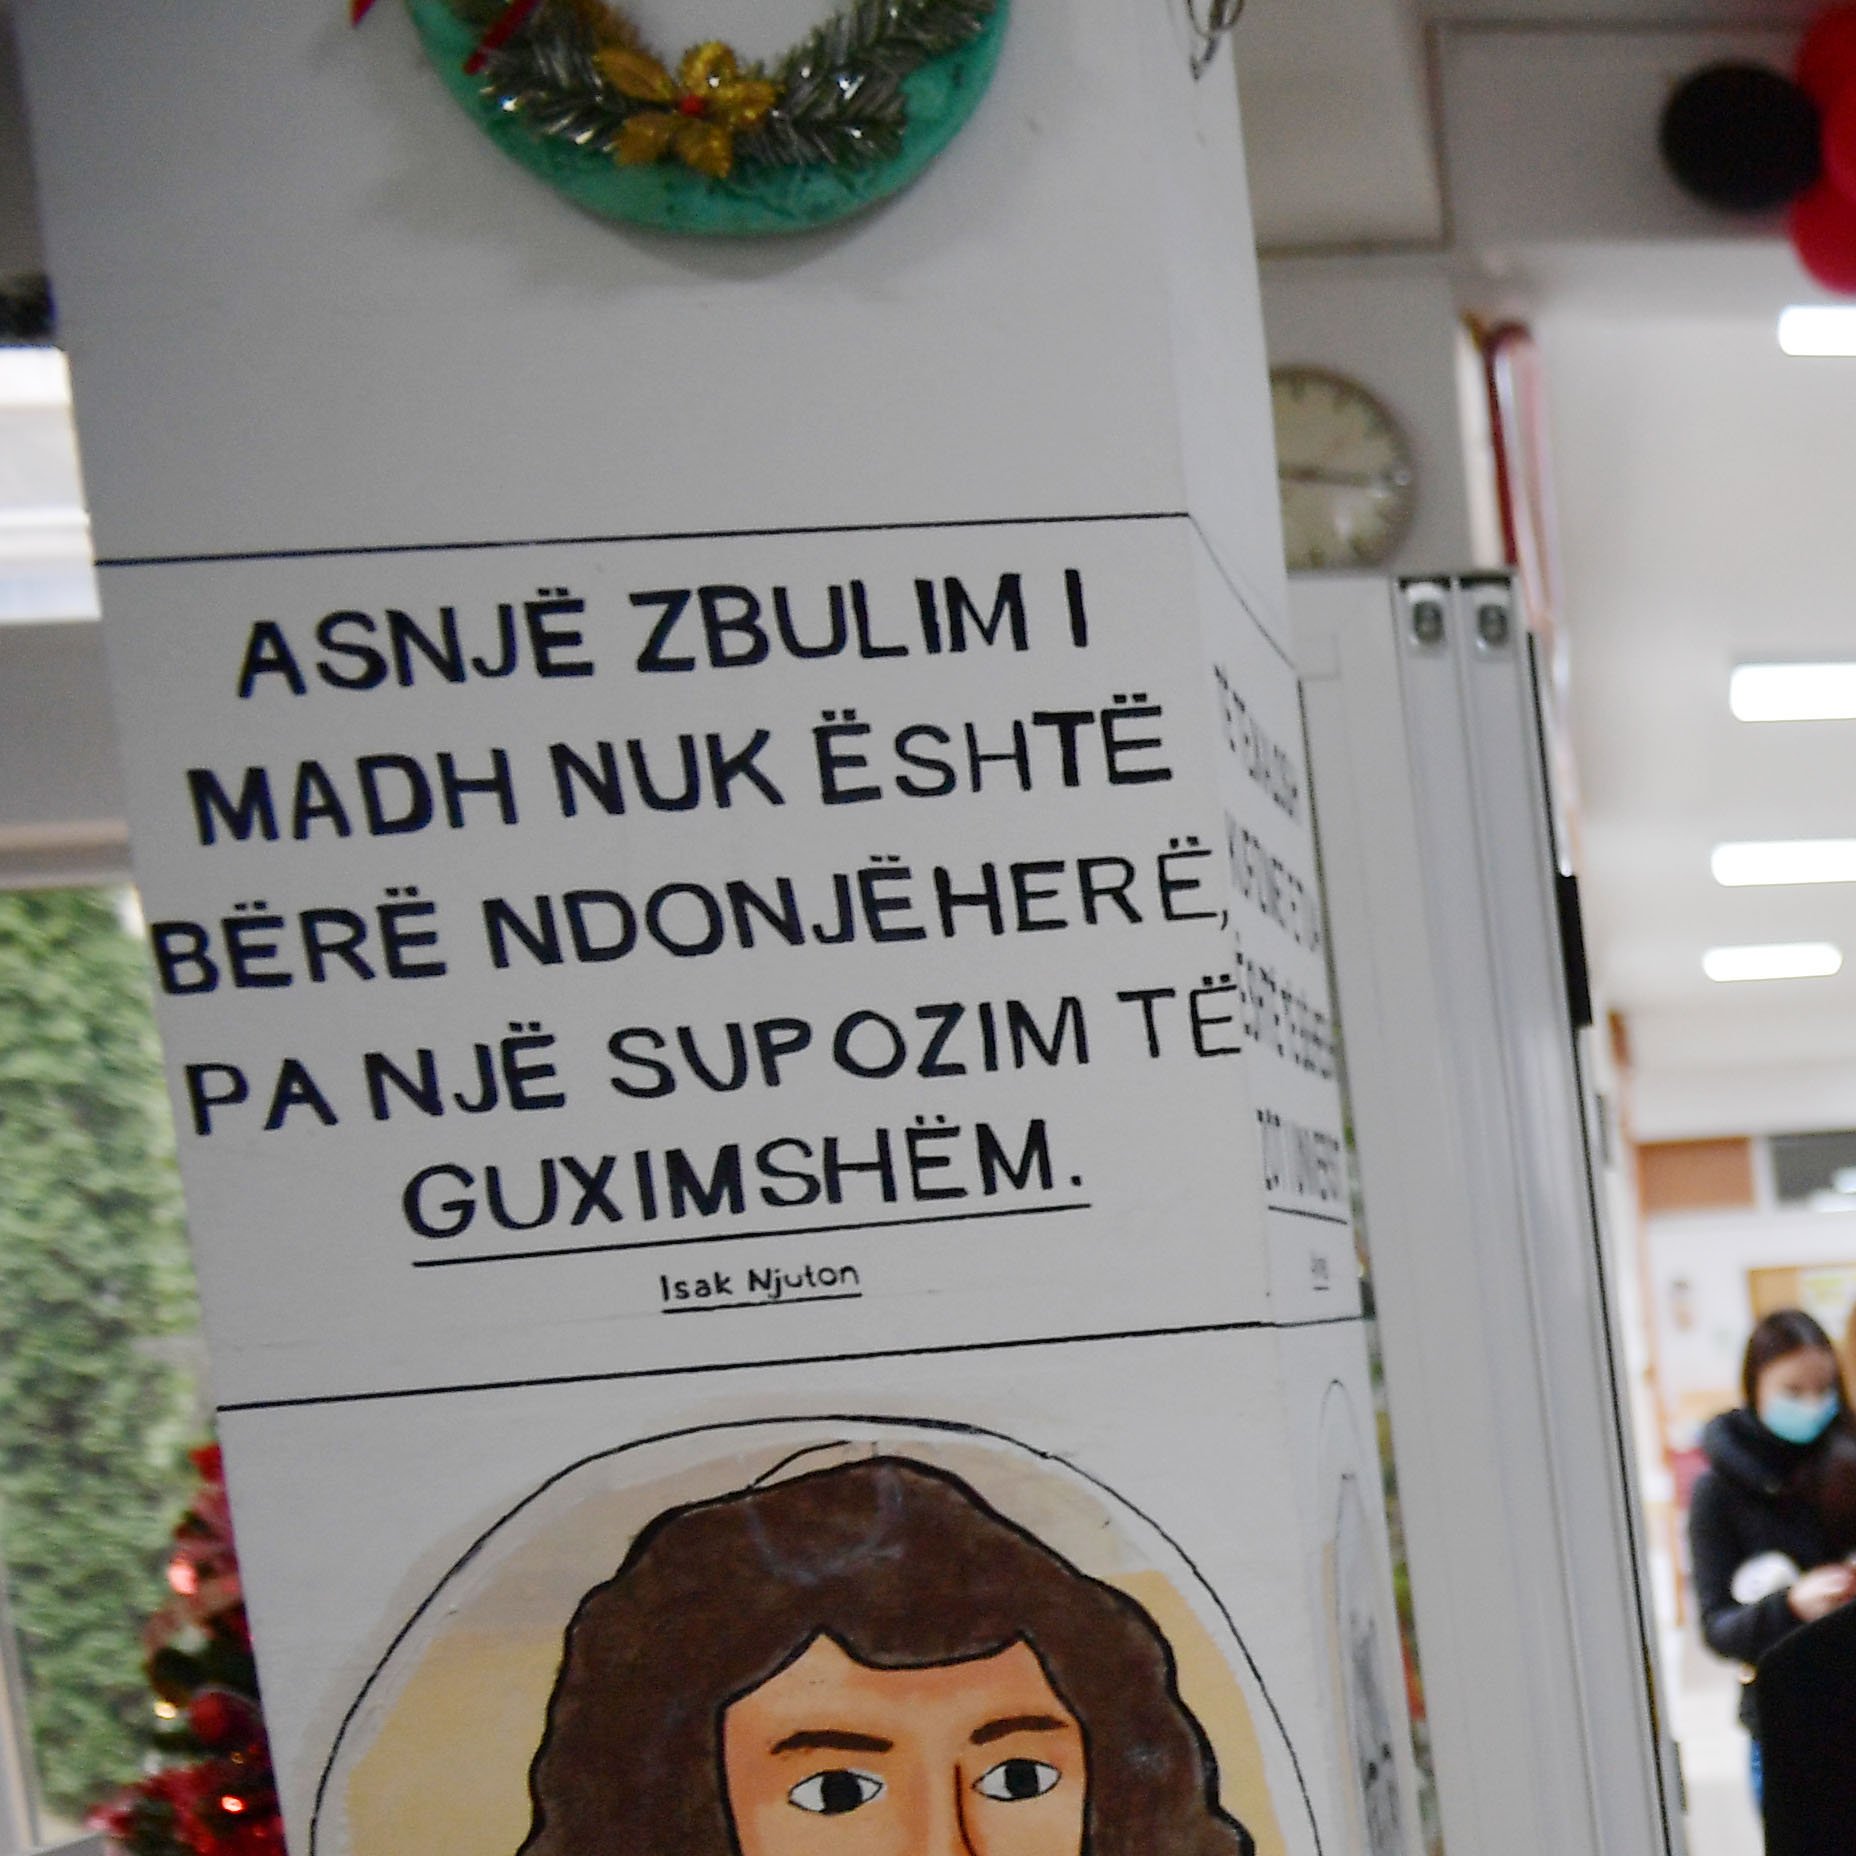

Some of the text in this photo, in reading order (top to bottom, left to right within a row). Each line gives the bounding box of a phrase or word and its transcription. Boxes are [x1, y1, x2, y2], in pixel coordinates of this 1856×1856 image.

[236, 567, 1089, 700] ASNJË ZBULIM I
[185, 747, 520, 847] MADH
[547, 727, 787, 819] NUK
[810, 691, 1174, 806] ËSHTË
[149, 884, 449, 997] BËRË
[481, 835, 1230, 970] NDONJËHERË,
[183, 1057, 340, 1138] PA
[362, 1020, 568, 1122] NJË
[606, 995, 1091, 1100] SUPOZIM
[1114, 972, 1243, 1060] TË
[401, 1113, 1083, 1240] GUXIMSHËM.
[659, 1264, 860, 1302] Isak Njuton
